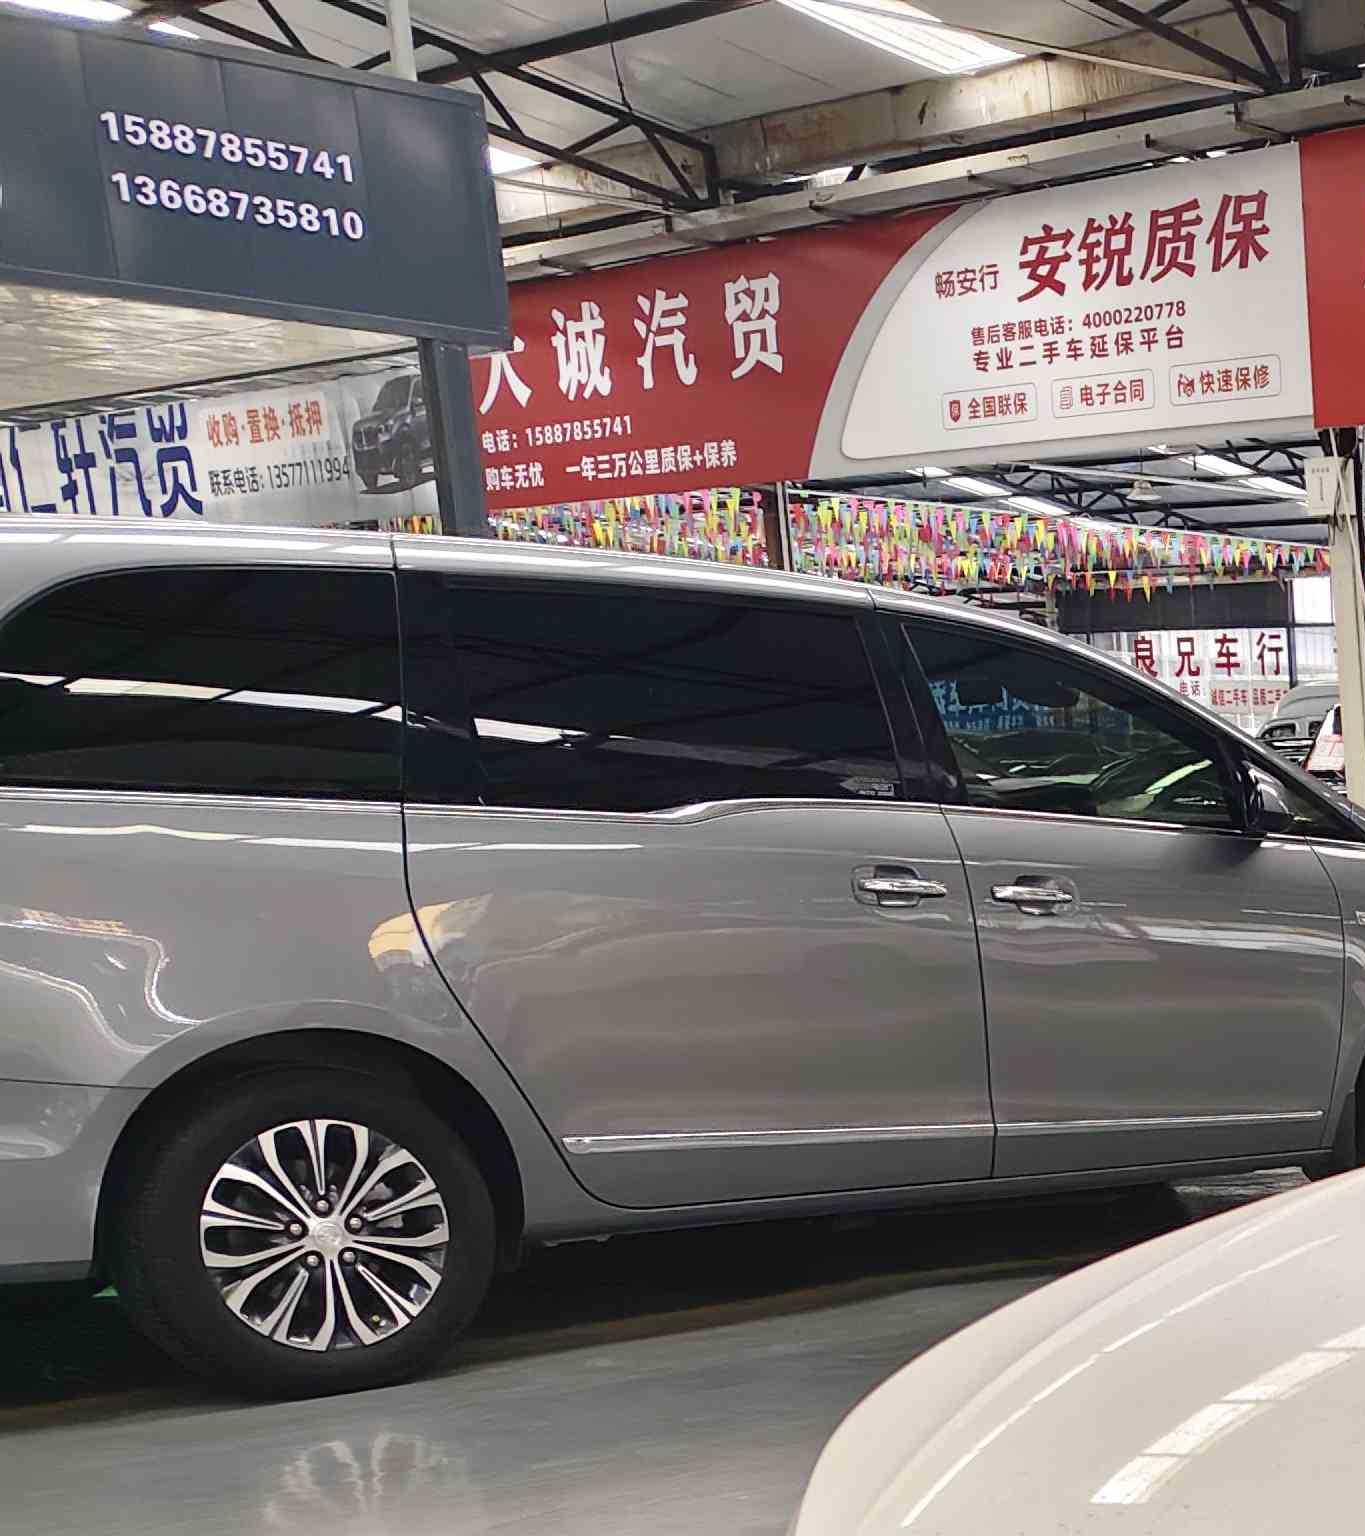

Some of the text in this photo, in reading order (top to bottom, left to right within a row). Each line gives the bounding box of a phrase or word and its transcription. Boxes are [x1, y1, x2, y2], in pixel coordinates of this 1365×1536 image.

[100, 110, 355, 184] 15887855741
[110, 171, 365, 241] 13668735810
[934, 189, 1272, 303] 畅安行 安锐质保
[972, 324, 1185, 373] 专业二手车延保平台
[1079, 378, 1145, 408] 电子合同
[1199, 364, 1271, 395] 快速保修
[967, 392, 1029, 421] 全国联保
[0, 403, 204, 518] 仁轩汽贸
[485, 439, 738, 491] 购车无忧 一年三万公里质保+保养
[1133, 631, 1284, 678] 良兄车行
